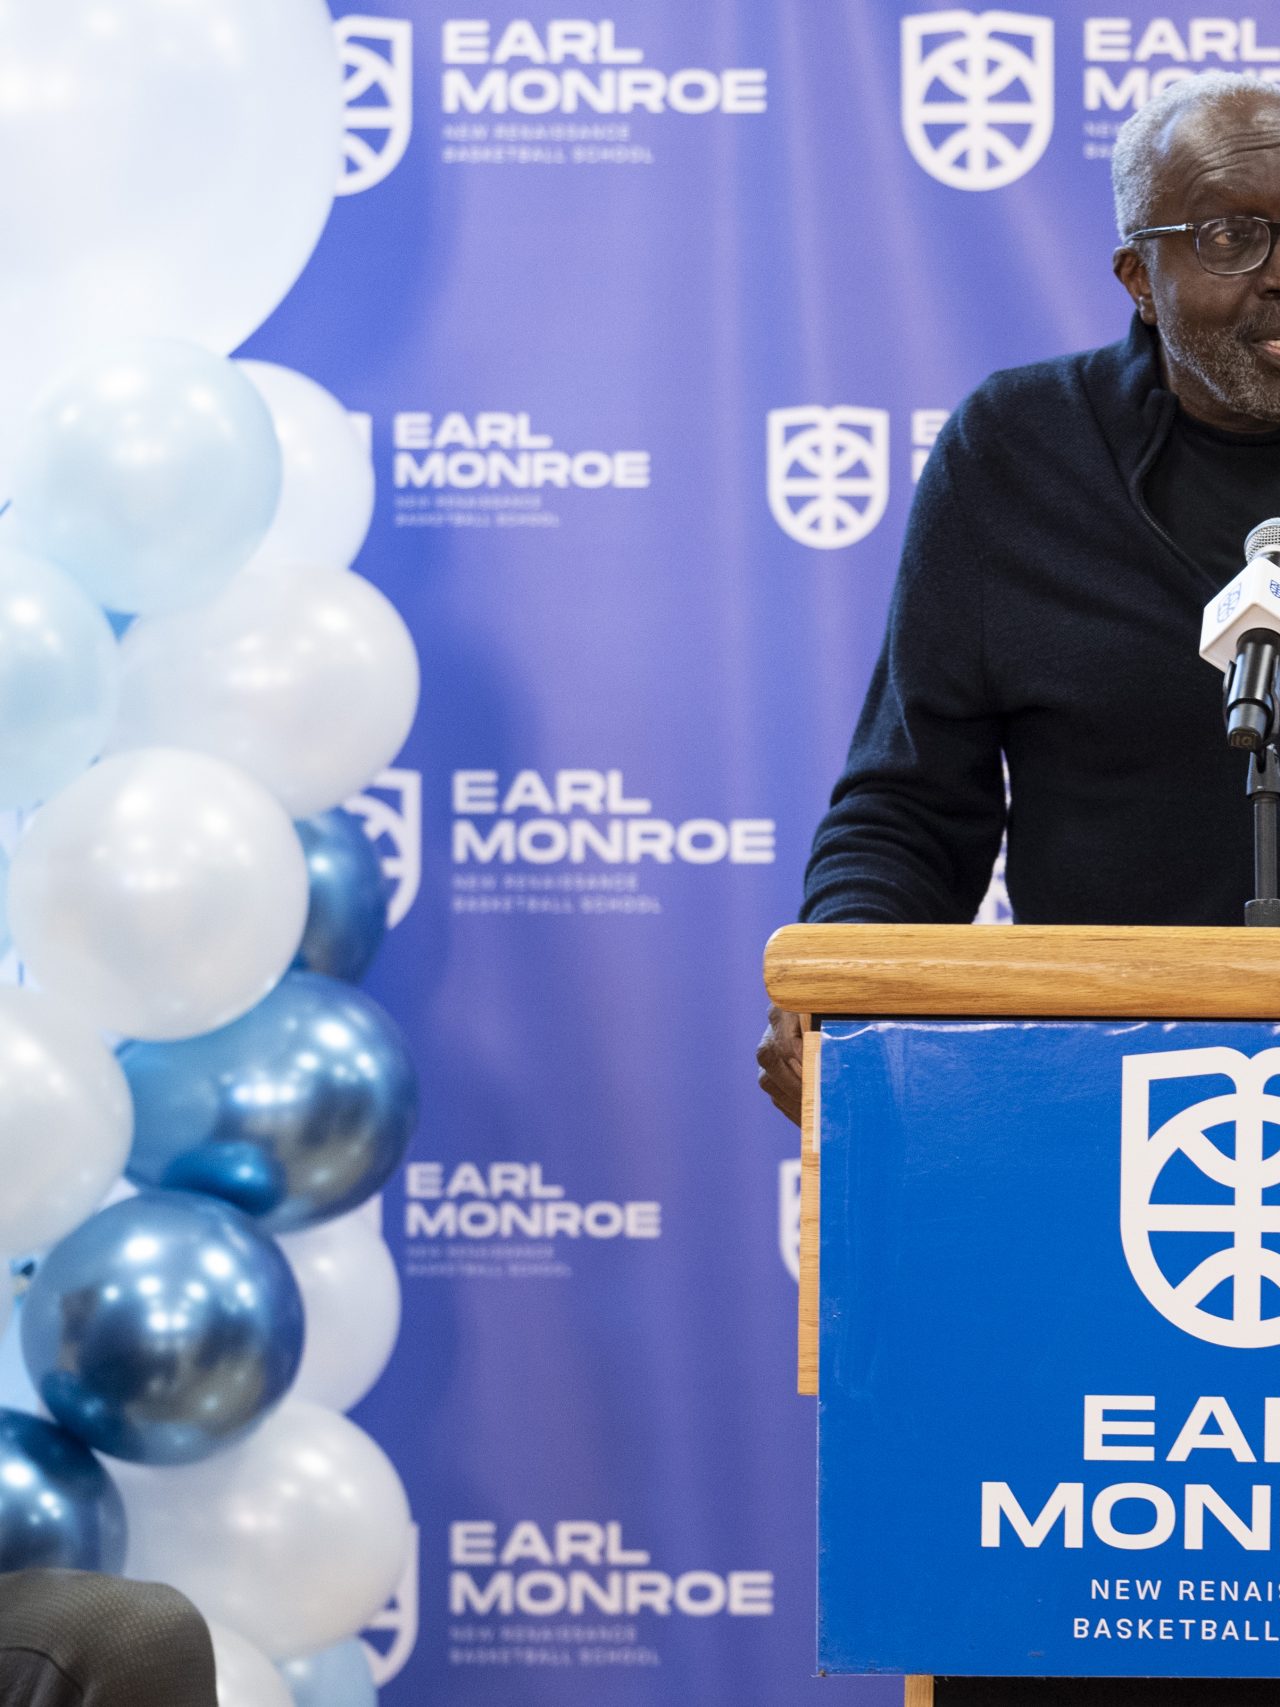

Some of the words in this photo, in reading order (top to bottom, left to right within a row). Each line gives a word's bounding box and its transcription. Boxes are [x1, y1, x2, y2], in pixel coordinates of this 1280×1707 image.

[442, 19, 644, 64] EARL
[442, 68, 767, 114] MONROE
[393, 412, 553, 449] EARL
[393, 450, 649, 489] MONROE
[452, 769, 651, 814] EARL
[452, 818, 775, 864] MONROE
[405, 1162, 565, 1199] EARL
[405, 1201, 661, 1239] MONROE
[450, 1520, 650, 1566] EARL
[449, 1570, 774, 1616] MONROE
[1090, 1578, 1162, 1601] NEW
[1073, 1617, 1280, 1642] BASKETBALL
